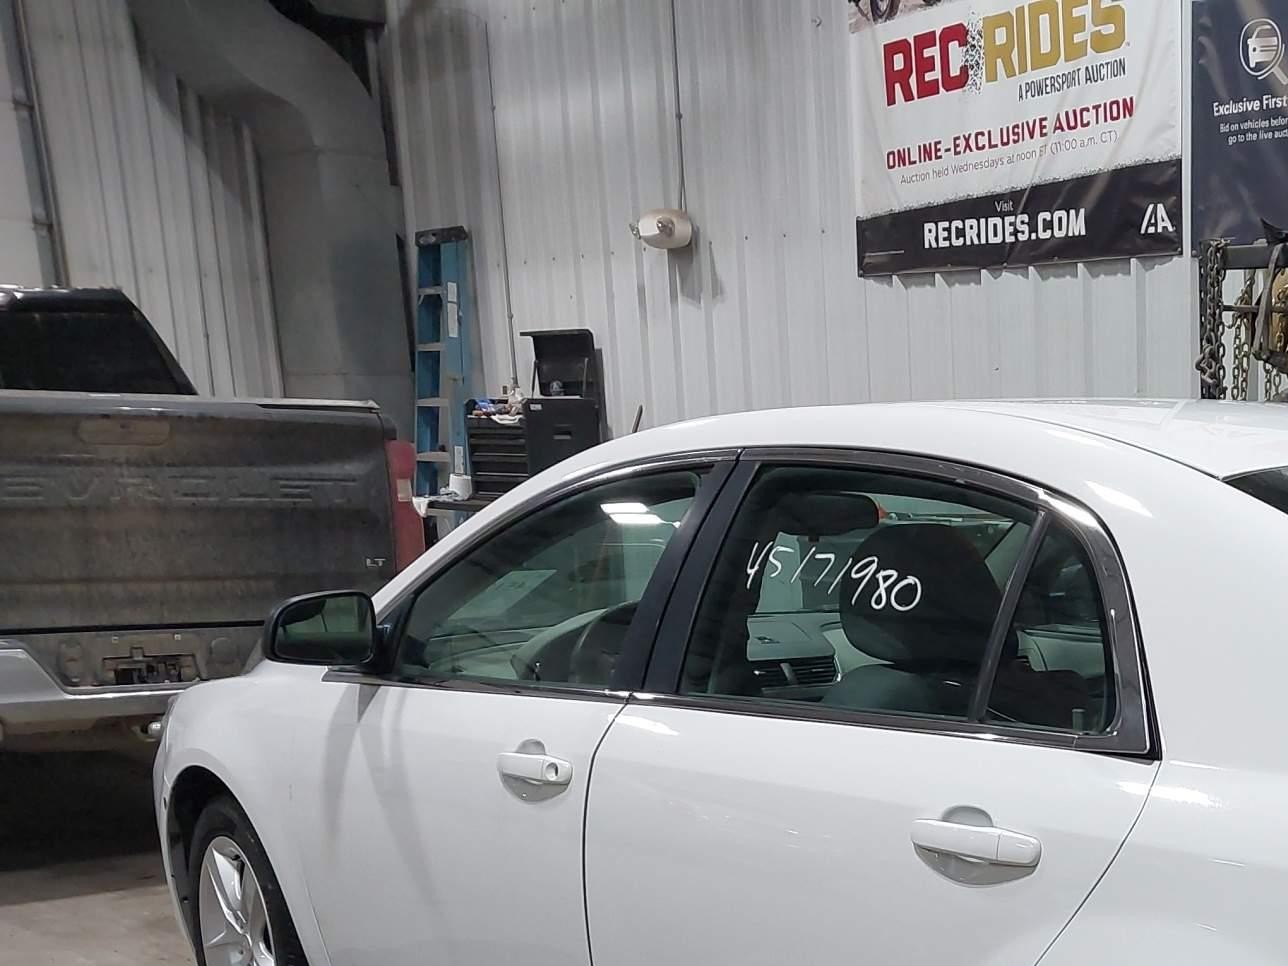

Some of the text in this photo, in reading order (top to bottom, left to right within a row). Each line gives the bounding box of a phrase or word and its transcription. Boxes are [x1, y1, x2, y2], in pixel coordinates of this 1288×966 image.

[883, 0, 1126, 107] REC RIDES
[1018, 57, 1126, 102] A POWERSPORT AUCTION
[1213, 98, 1260, 116] Exclusive
[1262, 95, 1288, 110] First
[886, 96, 1135, 170] ONLINE-EXCLUSIVE AUCTION
[1220, 123, 1230, 133] Bid
[1240, 119, 1269, 130] vehicles
[1228, 135, 1237, 145] go
[1238, 134, 1245, 142] to
[1246, 132, 1257, 141] the
[1259, 130, 1273, 139] live
[900, 170, 930, 184] Auction
[932, 165, 949, 178] held
[951, 156, 1004, 175] Wednesdays
[1006, 154, 1015, 164] at
[1016, 149, 1037, 161] noon
[994, 200, 1014, 212] Visit
[923, 208, 1086, 249] RECRIDES.COM
[366, 558, 386, 567] LT
[746, 541, 921, 611] 45171980
